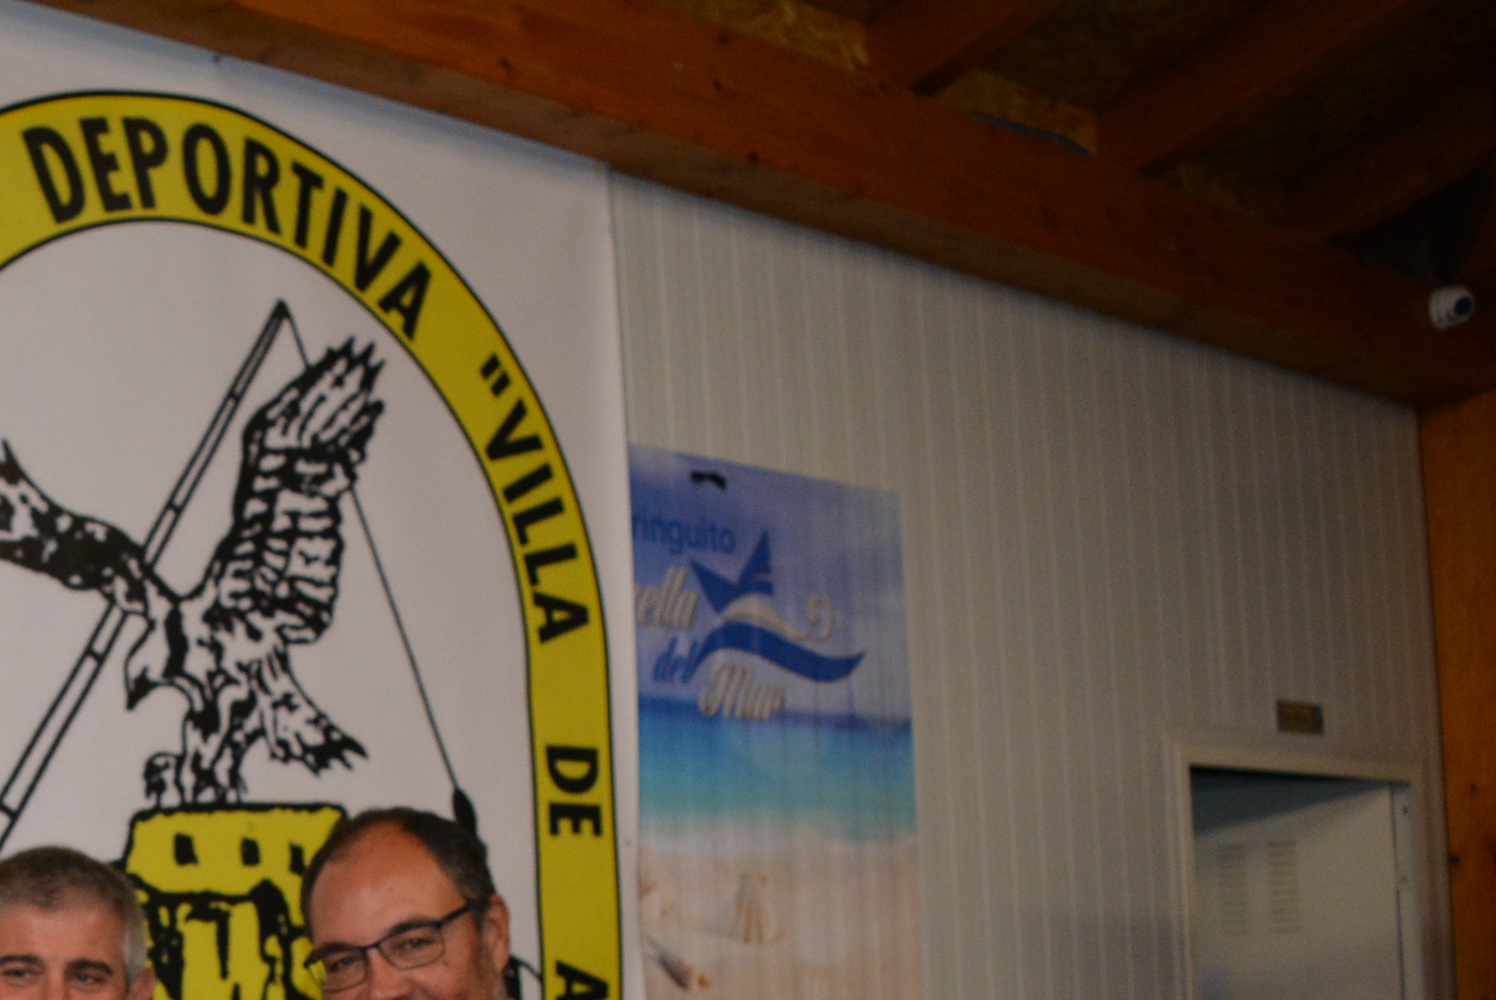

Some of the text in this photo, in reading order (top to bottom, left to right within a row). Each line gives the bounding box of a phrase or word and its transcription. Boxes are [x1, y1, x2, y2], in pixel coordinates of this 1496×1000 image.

[21, 116, 433, 341] DEPORTIVA
[480, 353, 590, 644] "VILLA
[545, 744, 603, 837] DE
